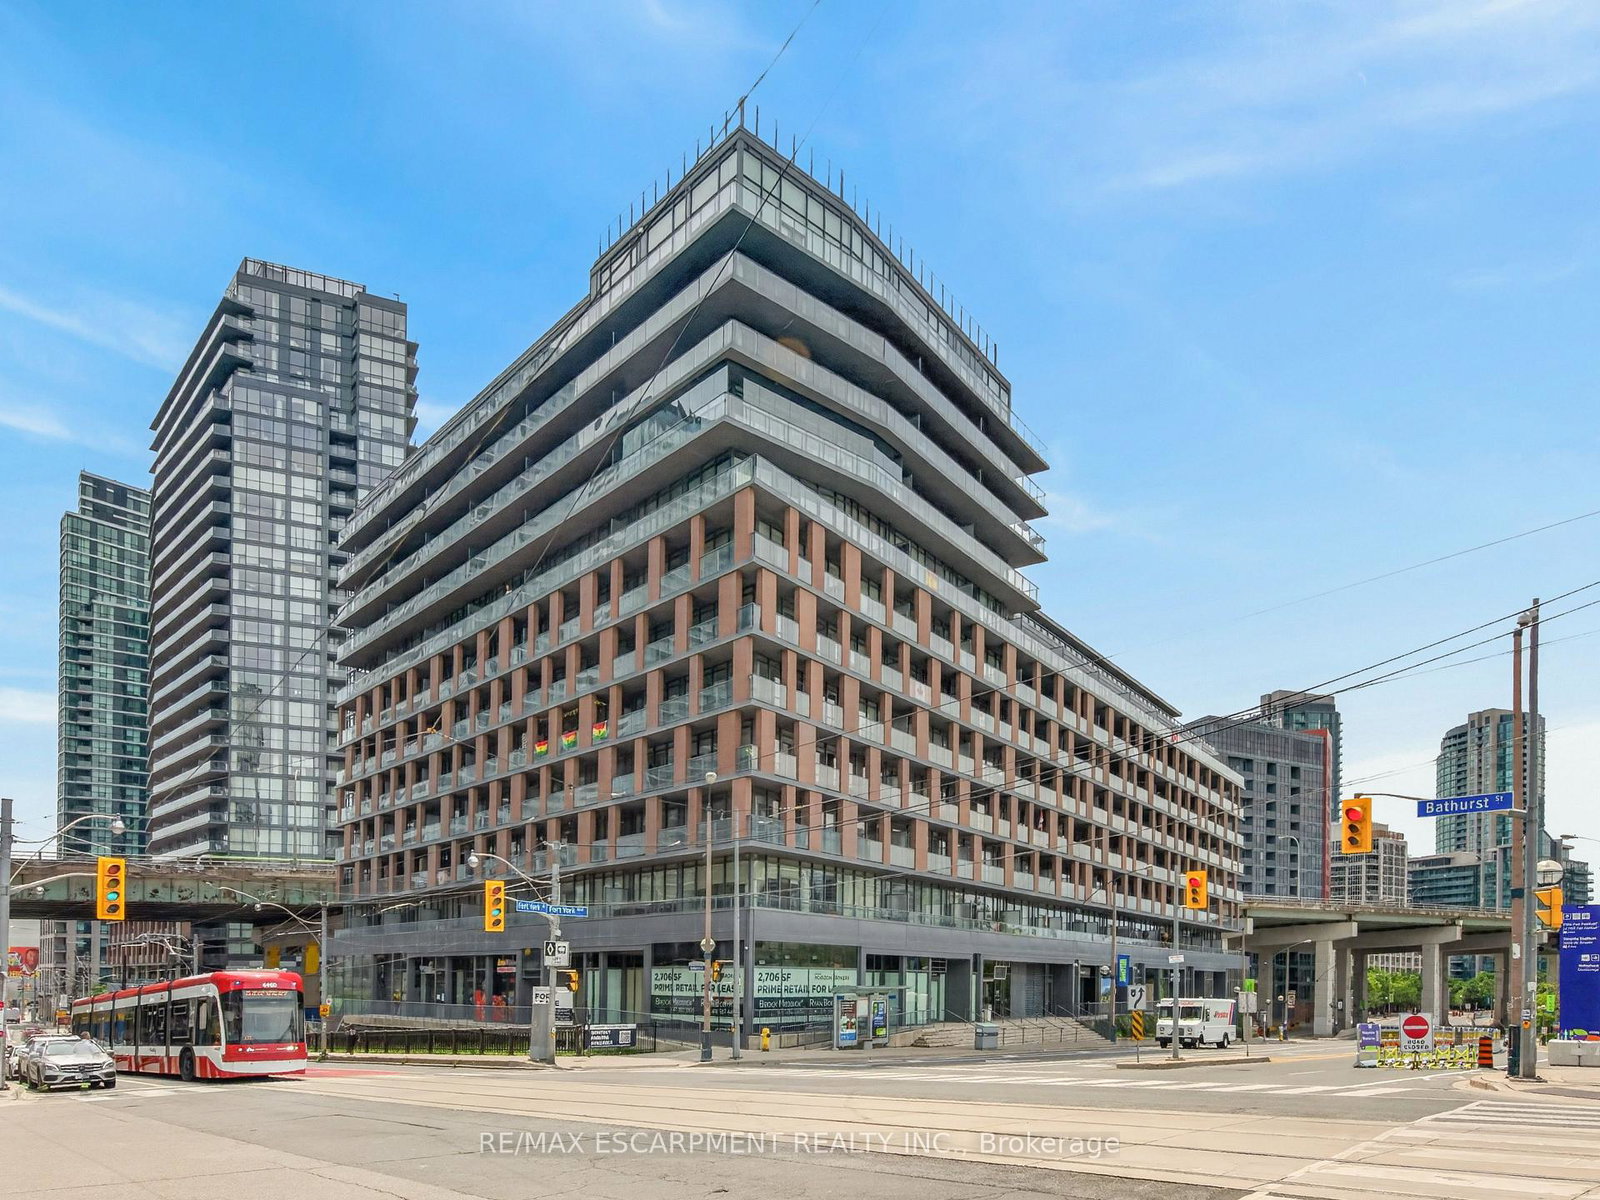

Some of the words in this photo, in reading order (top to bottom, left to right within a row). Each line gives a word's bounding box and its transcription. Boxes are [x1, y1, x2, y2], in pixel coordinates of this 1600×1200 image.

[1426, 797, 1489, 814] Bathurst
[1495, 794, 1504, 802] St
[549, 905, 561, 913] Fort
[673, 972, 682, 981] SF
[758, 972, 780, 983] 2,706
[781, 973, 792, 982] SF
[701, 984, 716, 993] FR
[718, 984, 735, 993] LEAS
[757, 985, 782, 994] PRIME
[784, 985, 810, 994] RETAIL
[811, 984, 827, 994] FOR
